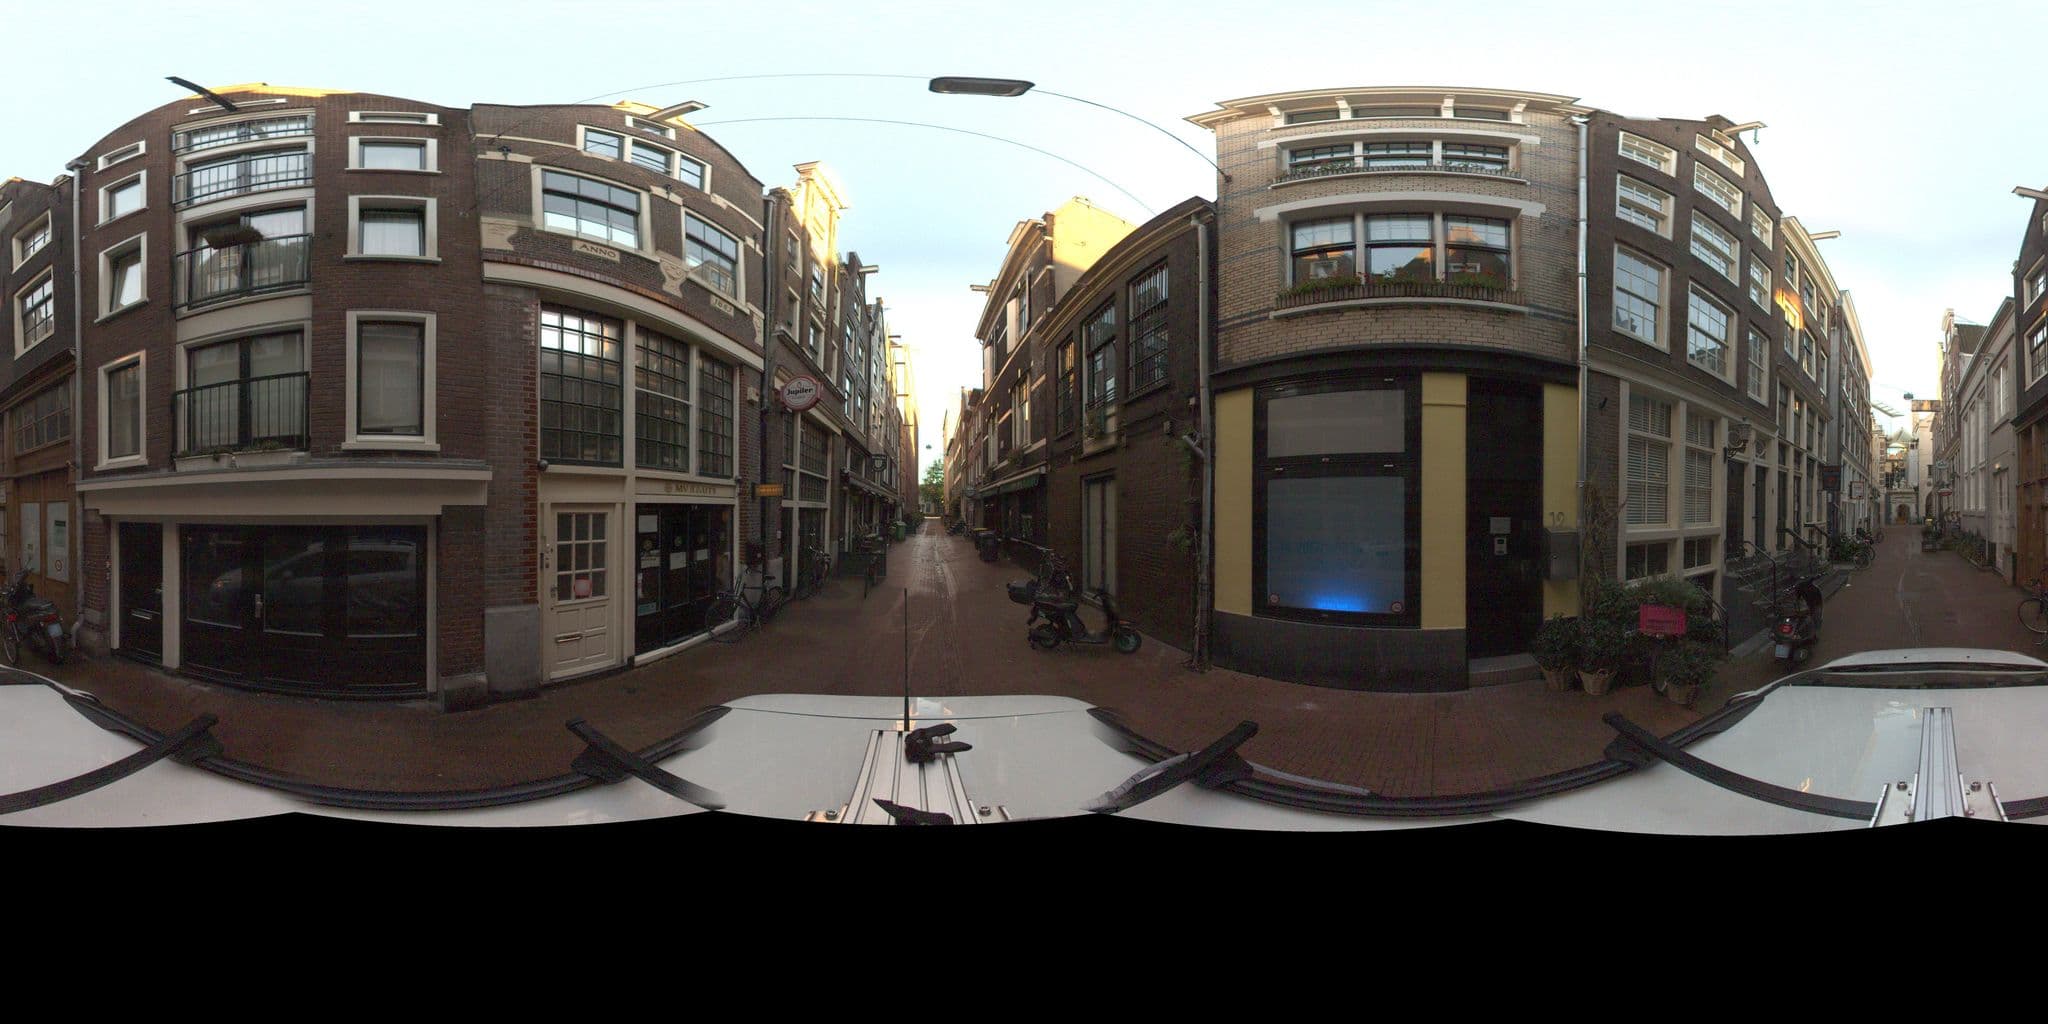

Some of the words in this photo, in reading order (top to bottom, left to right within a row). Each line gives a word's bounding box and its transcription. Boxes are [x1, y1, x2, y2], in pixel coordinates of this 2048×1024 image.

[579, 244, 616, 258] ANNO
[786, 386, 814, 396] Jupiler
[1550, 512, 1567, 529] 12
